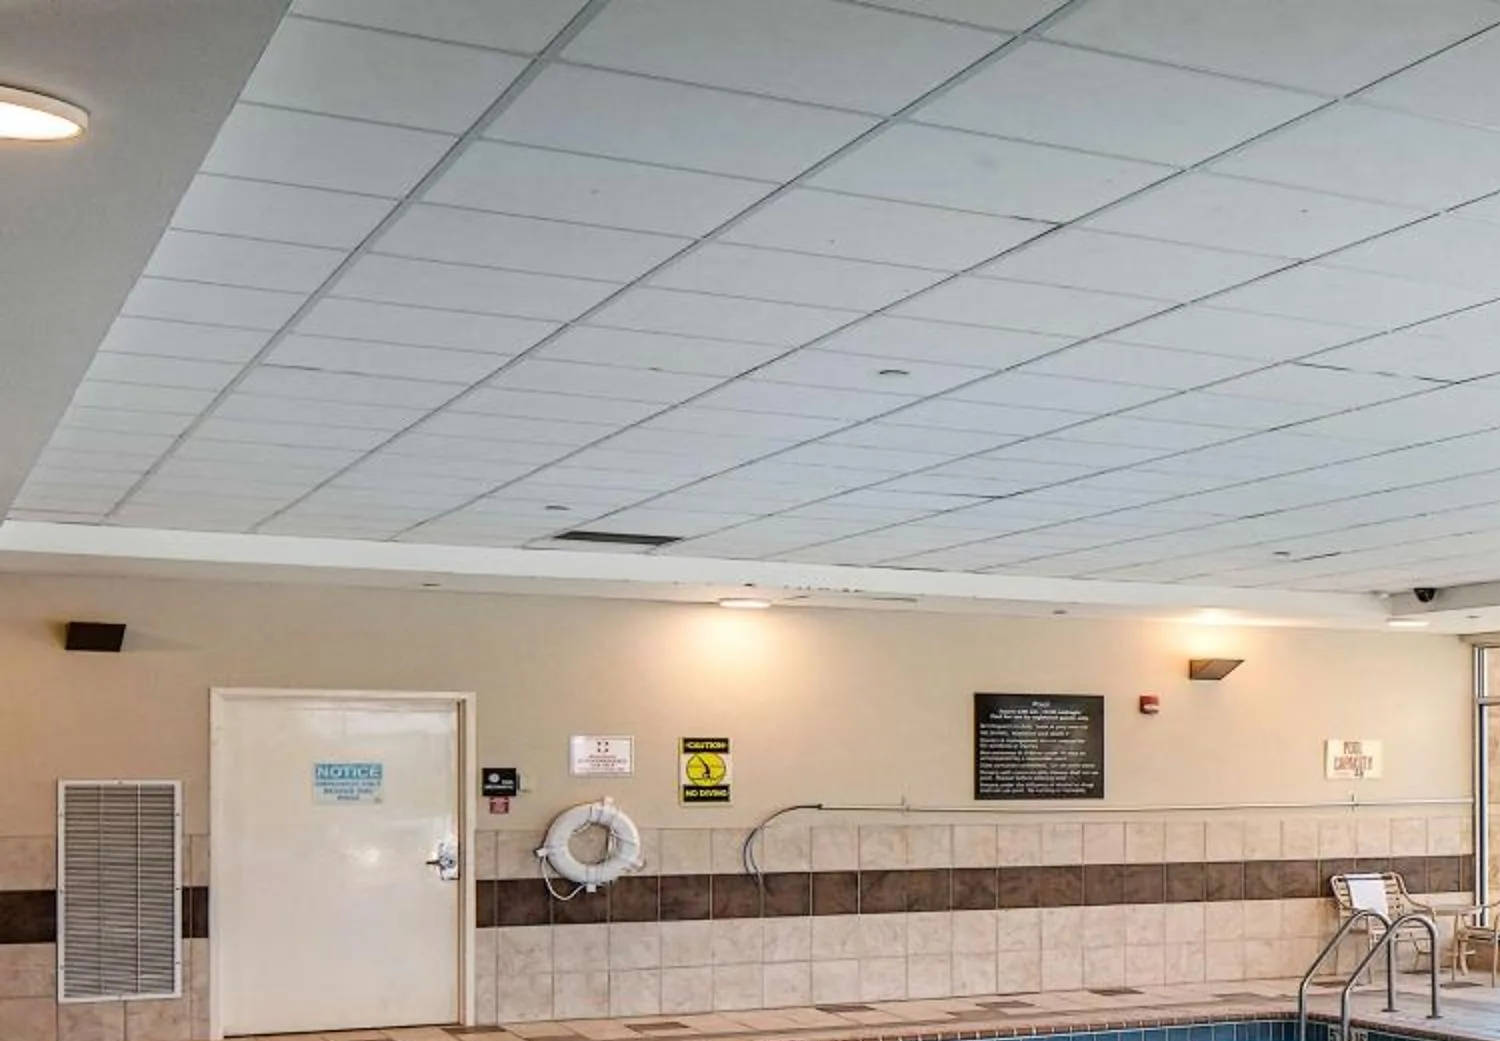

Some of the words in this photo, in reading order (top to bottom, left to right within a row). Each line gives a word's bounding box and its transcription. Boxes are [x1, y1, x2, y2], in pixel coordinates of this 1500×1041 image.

[687, 742, 722, 750] CAUTION
[317, 766, 381, 777] NOTICE
[685, 789, 698, 797] NO
[700, 789, 728, 797] DIVING
